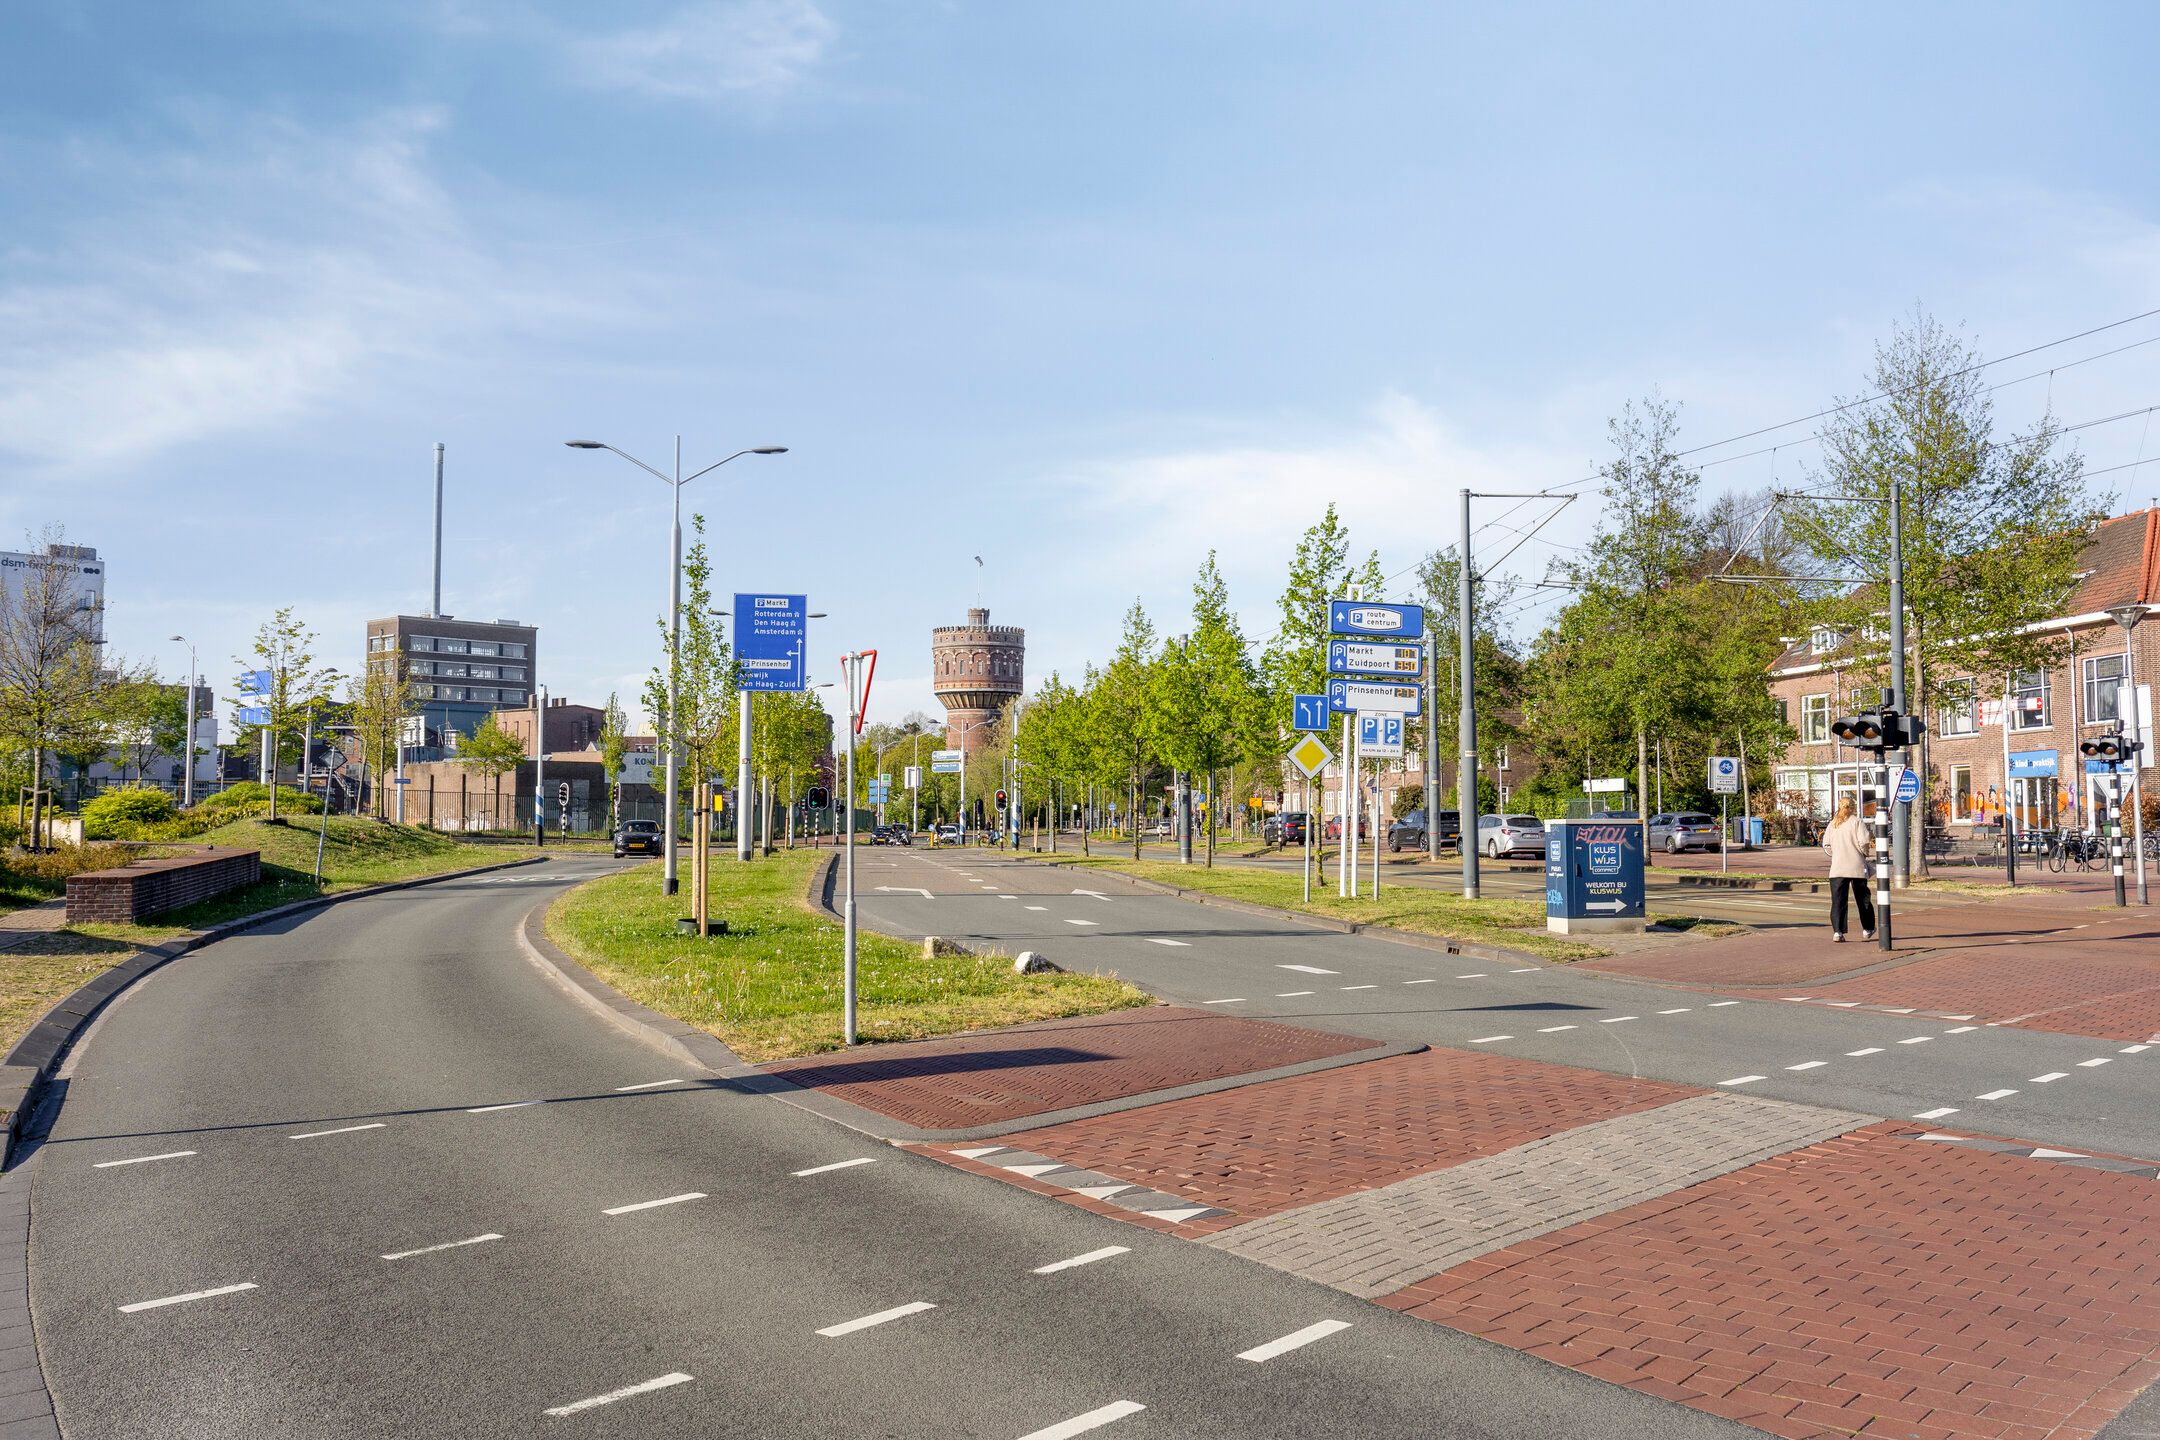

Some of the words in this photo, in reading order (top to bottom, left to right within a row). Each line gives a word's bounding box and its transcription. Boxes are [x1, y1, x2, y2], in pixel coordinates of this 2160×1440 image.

[1348, 646, 1374, 655] Markt
[1348, 659, 1390, 668] Zuidpoort
[1348, 685, 1393, 695] Prinsenhof
[1364, 719, 1375, 733] P
[1387, 720, 1397, 734] P
[1593, 846, 1617, 854] KLUS
[1594, 854, 1617, 865] WIJS
